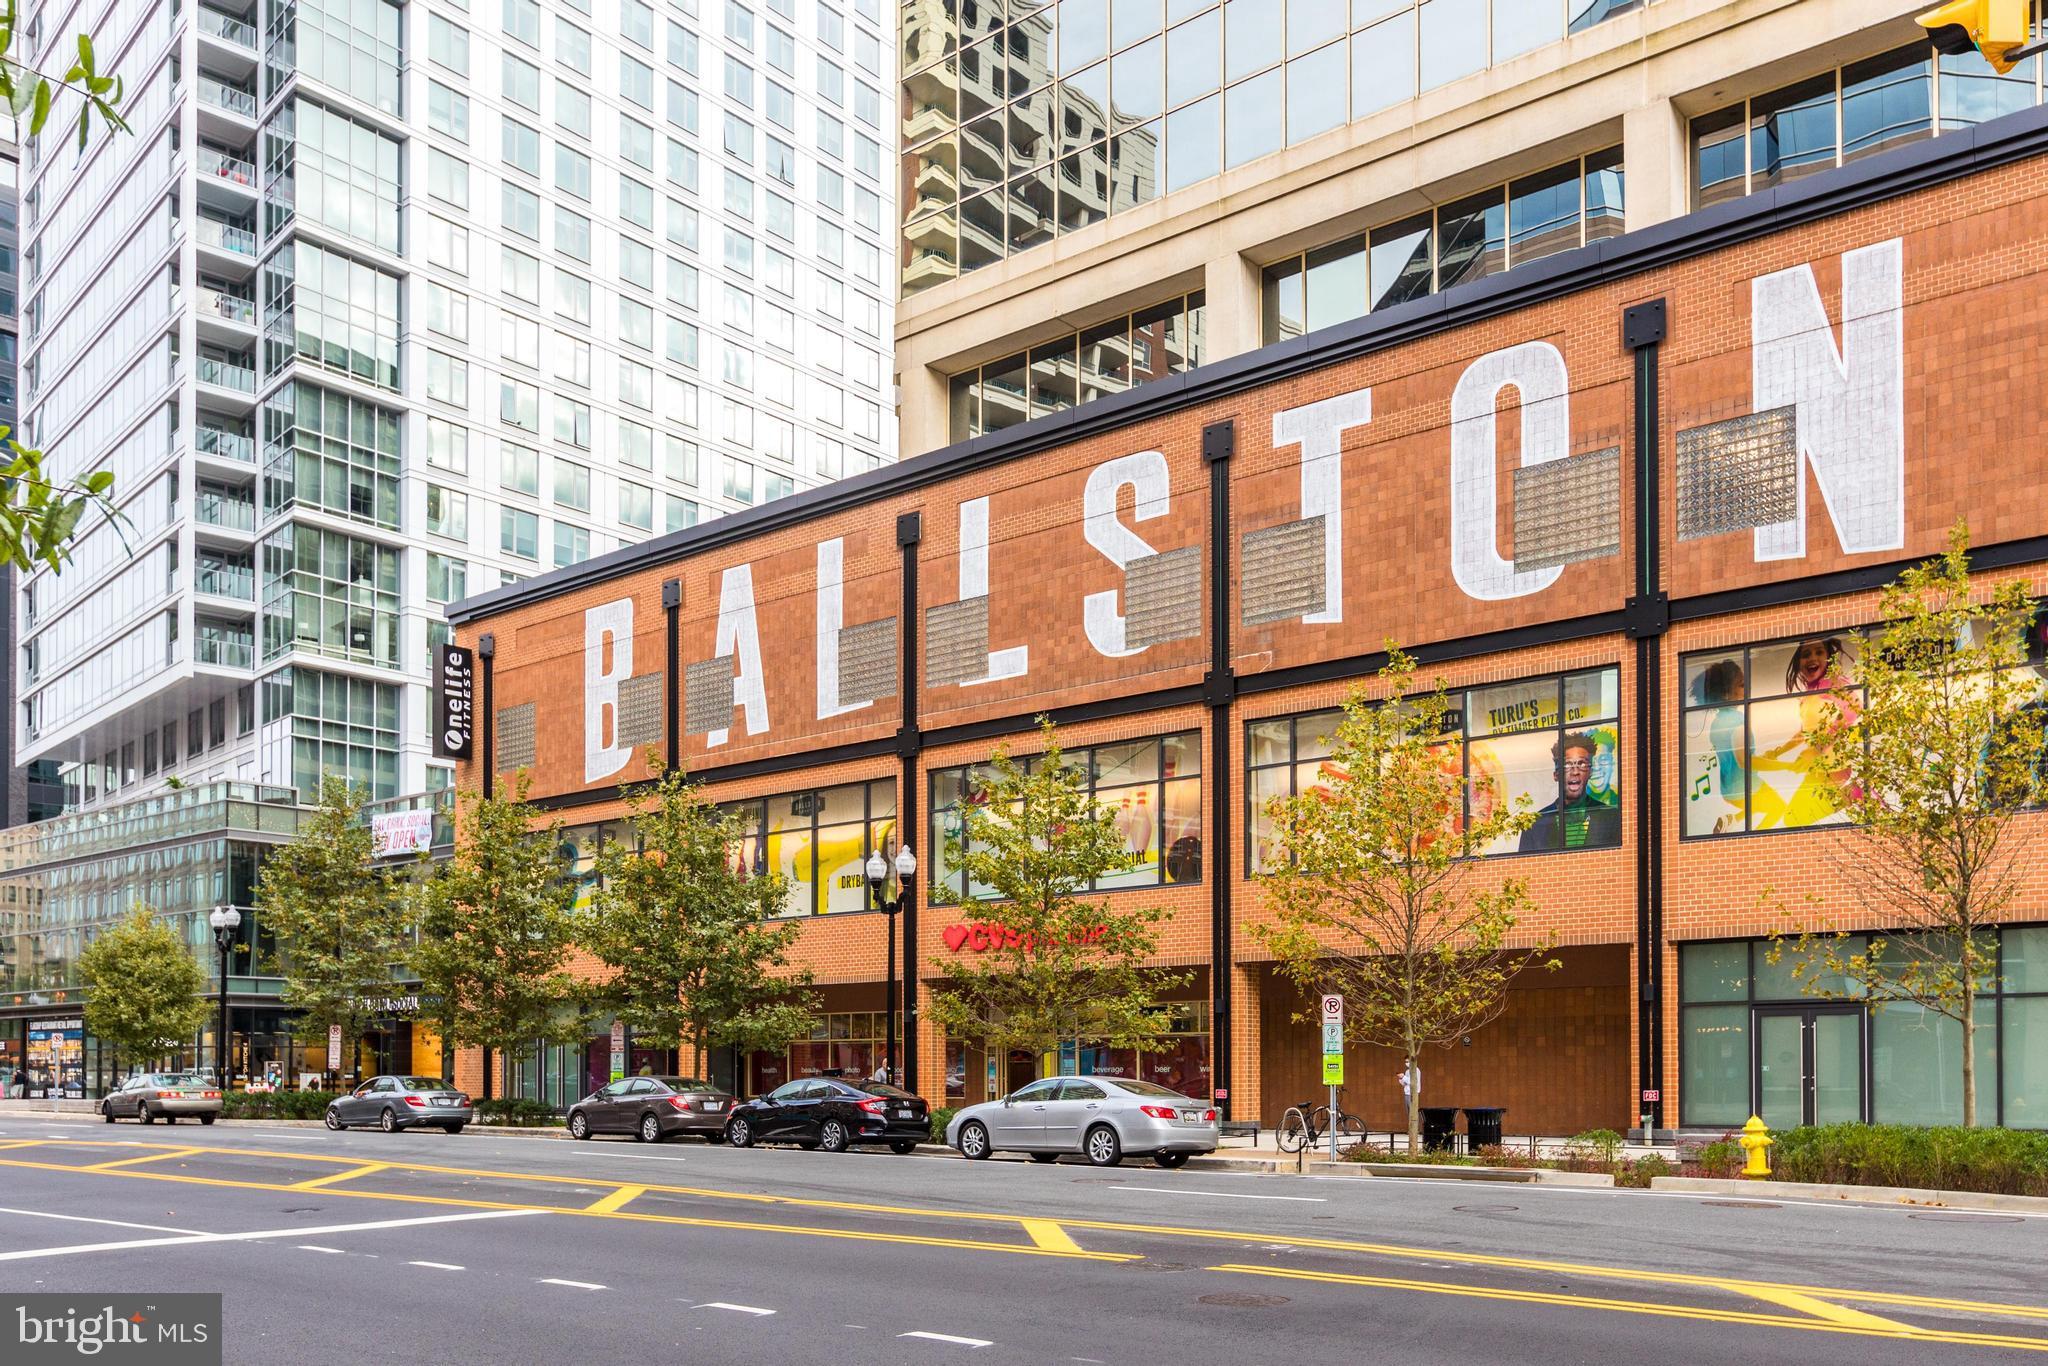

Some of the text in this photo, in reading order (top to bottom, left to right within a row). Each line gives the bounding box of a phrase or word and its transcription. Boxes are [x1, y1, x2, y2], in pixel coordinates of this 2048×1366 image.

[584, 236, 1905, 785] BALLSTON
[463, 668, 471, 739] FITNESS
[1489, 699, 1539, 727] TURU'S
[1541, 713, 1559, 727] PIZZ
[1568, 708, 1583, 721] CO.
[392, 830, 416, 849] OPEN
[841, 874, 865, 889] DRYBA
[844, 1066, 861, 1075] photo
[1091, 1065, 1124, 1075] beverage
[1154, 1065, 1171, 1073] beer
